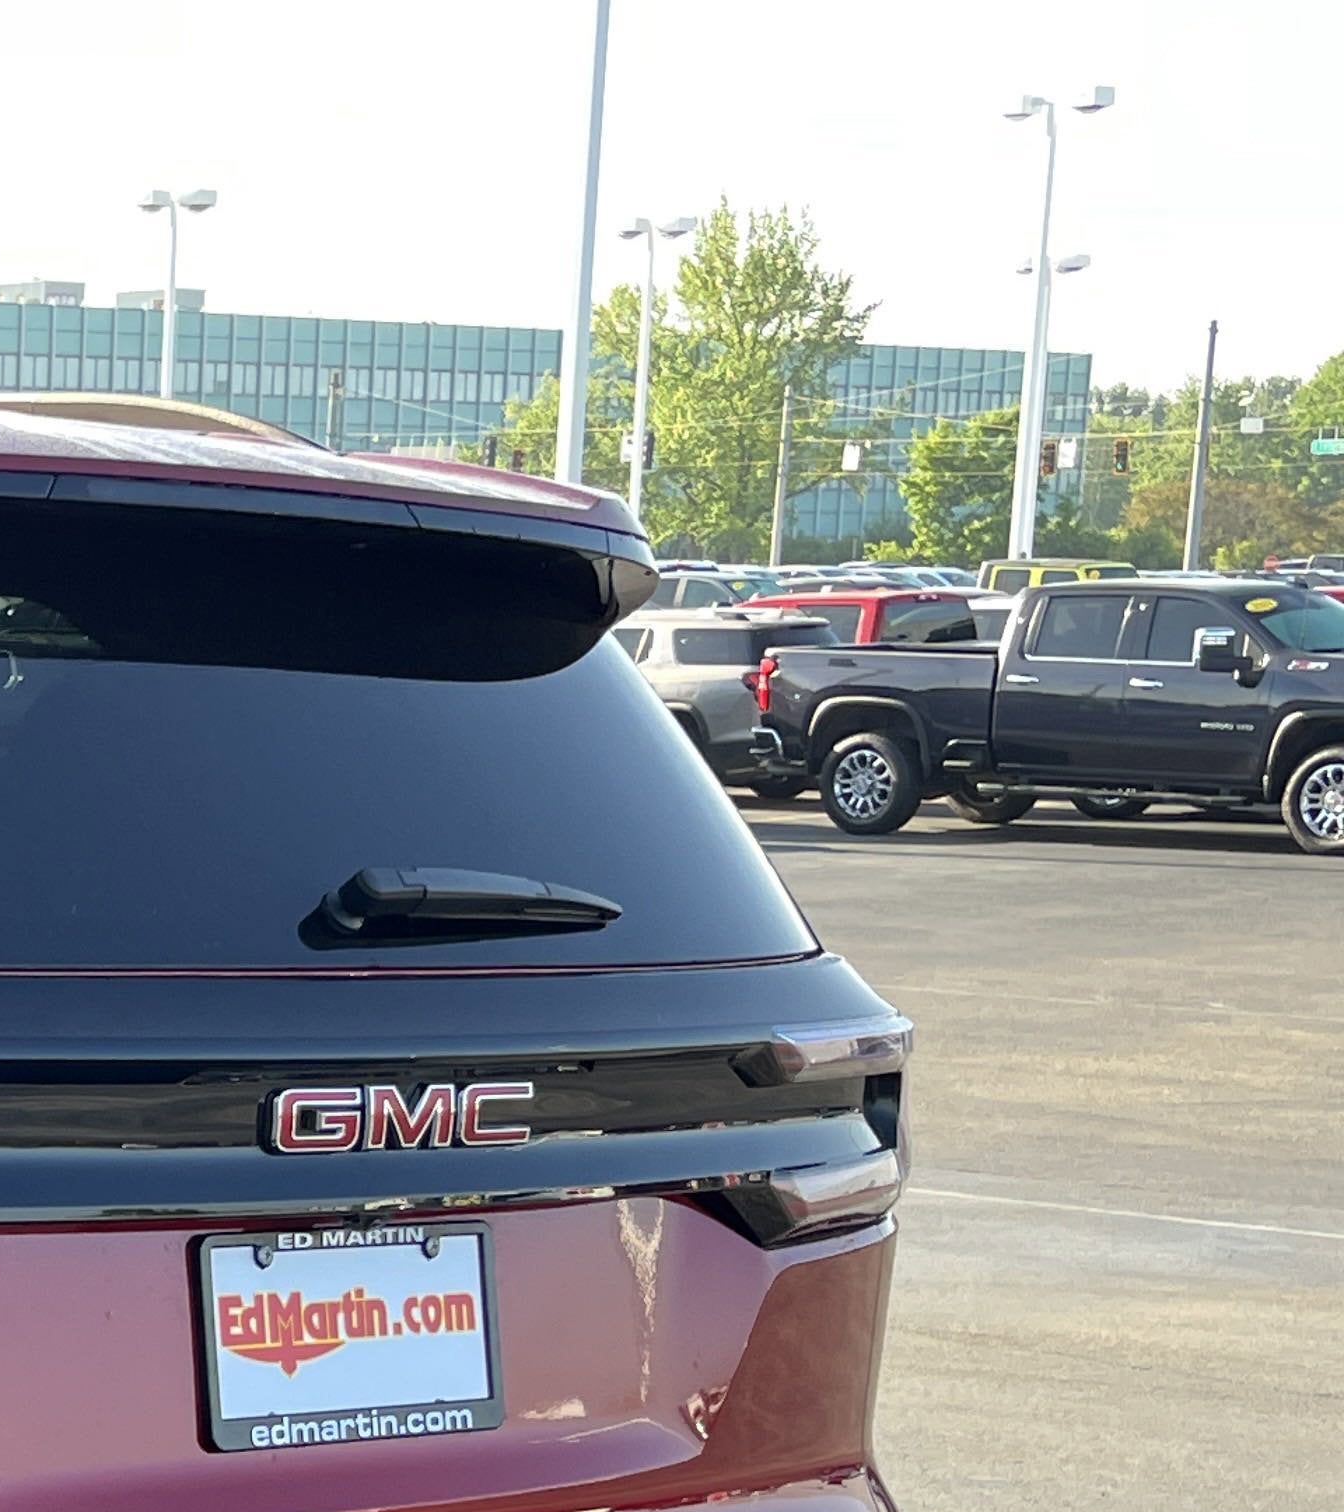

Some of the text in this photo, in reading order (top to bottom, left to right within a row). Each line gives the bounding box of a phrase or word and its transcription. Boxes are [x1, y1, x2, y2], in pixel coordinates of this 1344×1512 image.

[269, 1082, 534, 1153] GMC
[278, 1226, 425, 1250] ED MARTIN
[217, 1287, 476, 1347] EdMartin.com
[251, 1407, 474, 1447] edmartin.com
